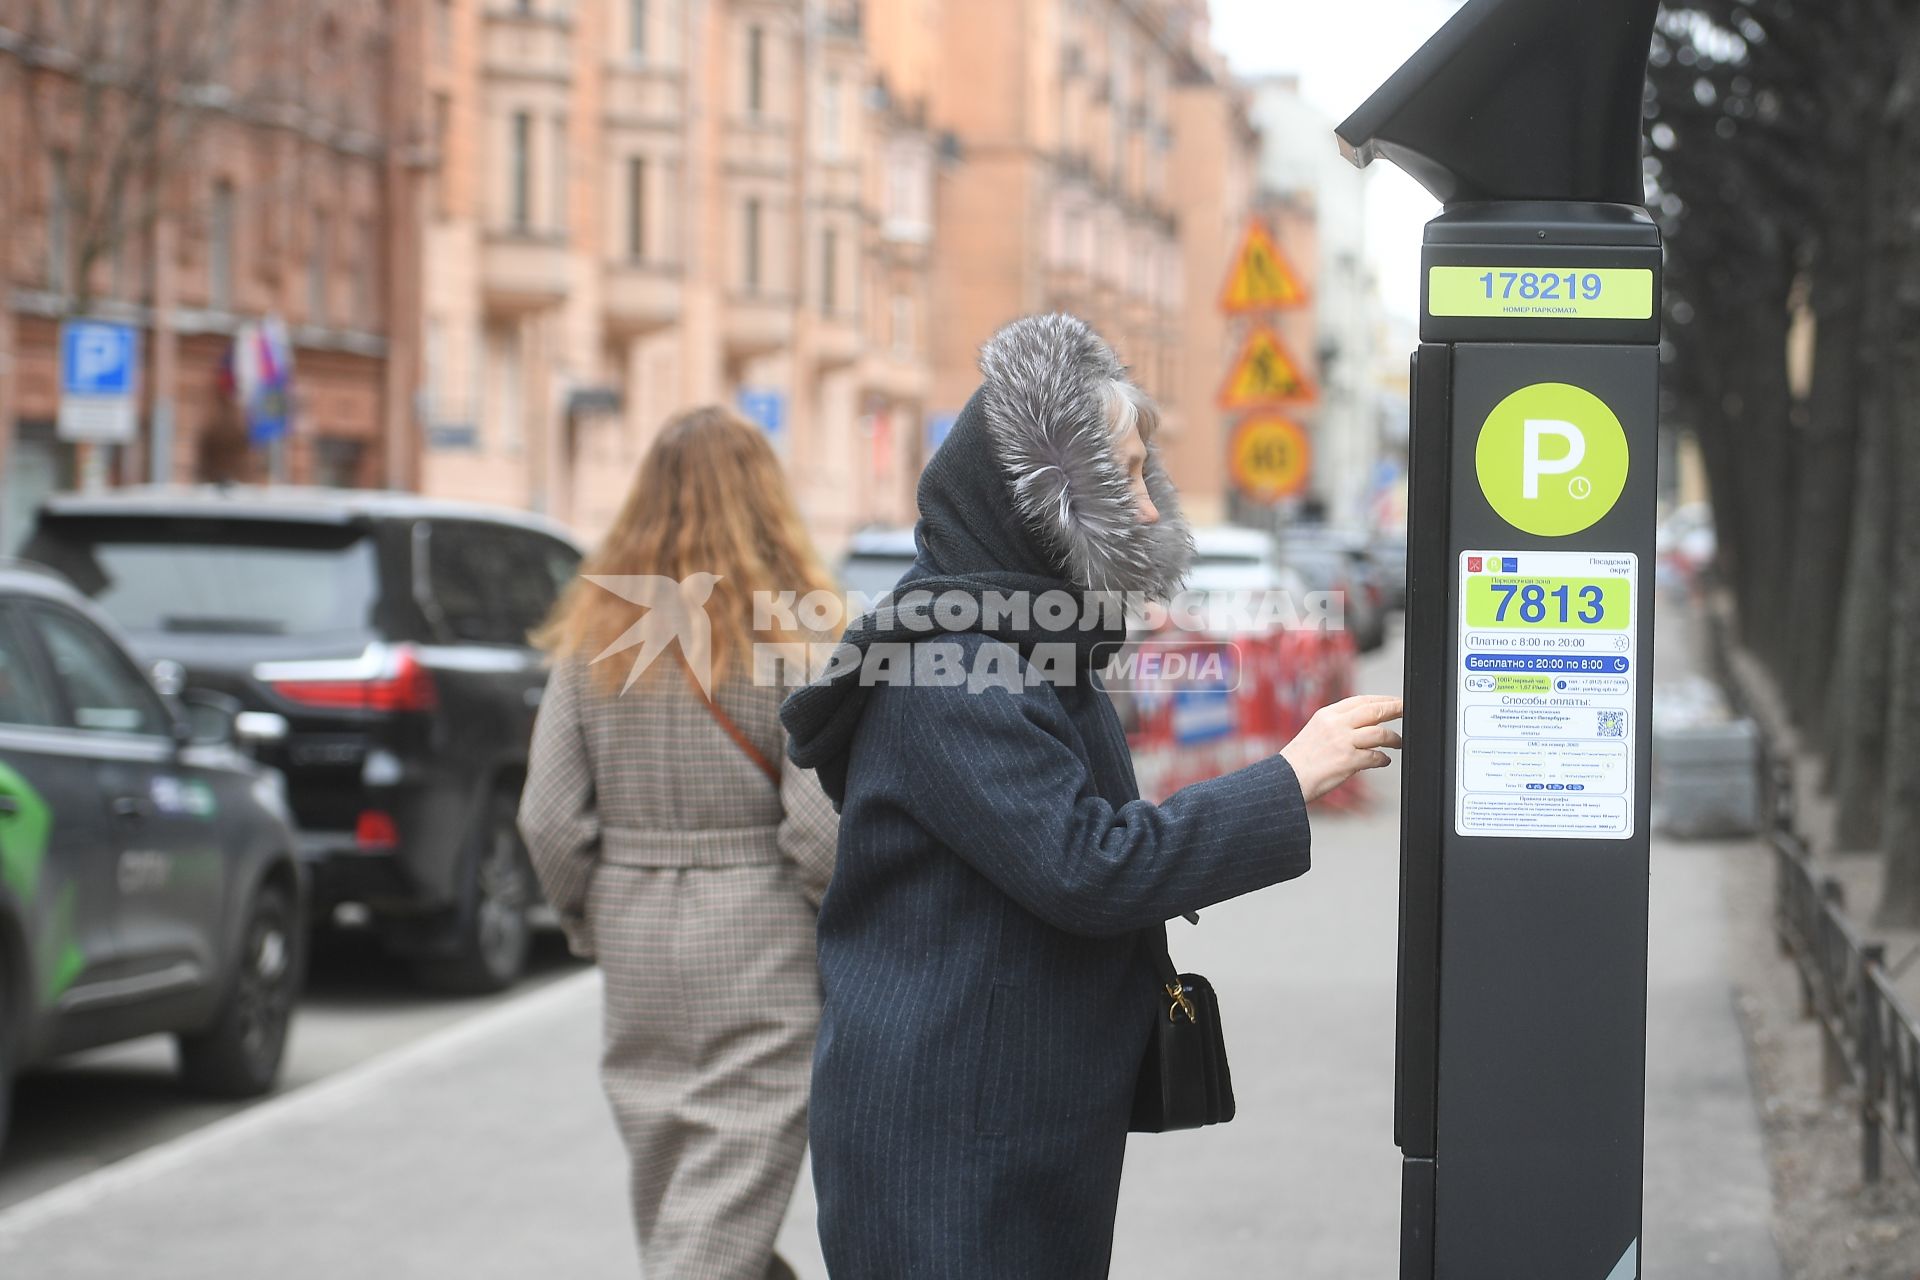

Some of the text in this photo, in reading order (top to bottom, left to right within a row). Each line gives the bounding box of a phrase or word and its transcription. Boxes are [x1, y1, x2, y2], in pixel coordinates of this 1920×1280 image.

[1479, 272, 1602, 300] 178219
[1531, 306, 1578, 314] ПАРКОМАТА
[1522, 419, 1586, 500] P
[1490, 584, 1605, 624] 7813
[1470, 637, 1509, 646] Платно
[1519, 637, 1541, 647] 8:00
[1543, 639, 1555, 647] по
[1558, 638, 1585, 647] 20:00
[1470, 657, 1603, 670] Бесплатно с 20:00 по 8:00
[1501, 695, 1591, 706] Способы оплаты:
